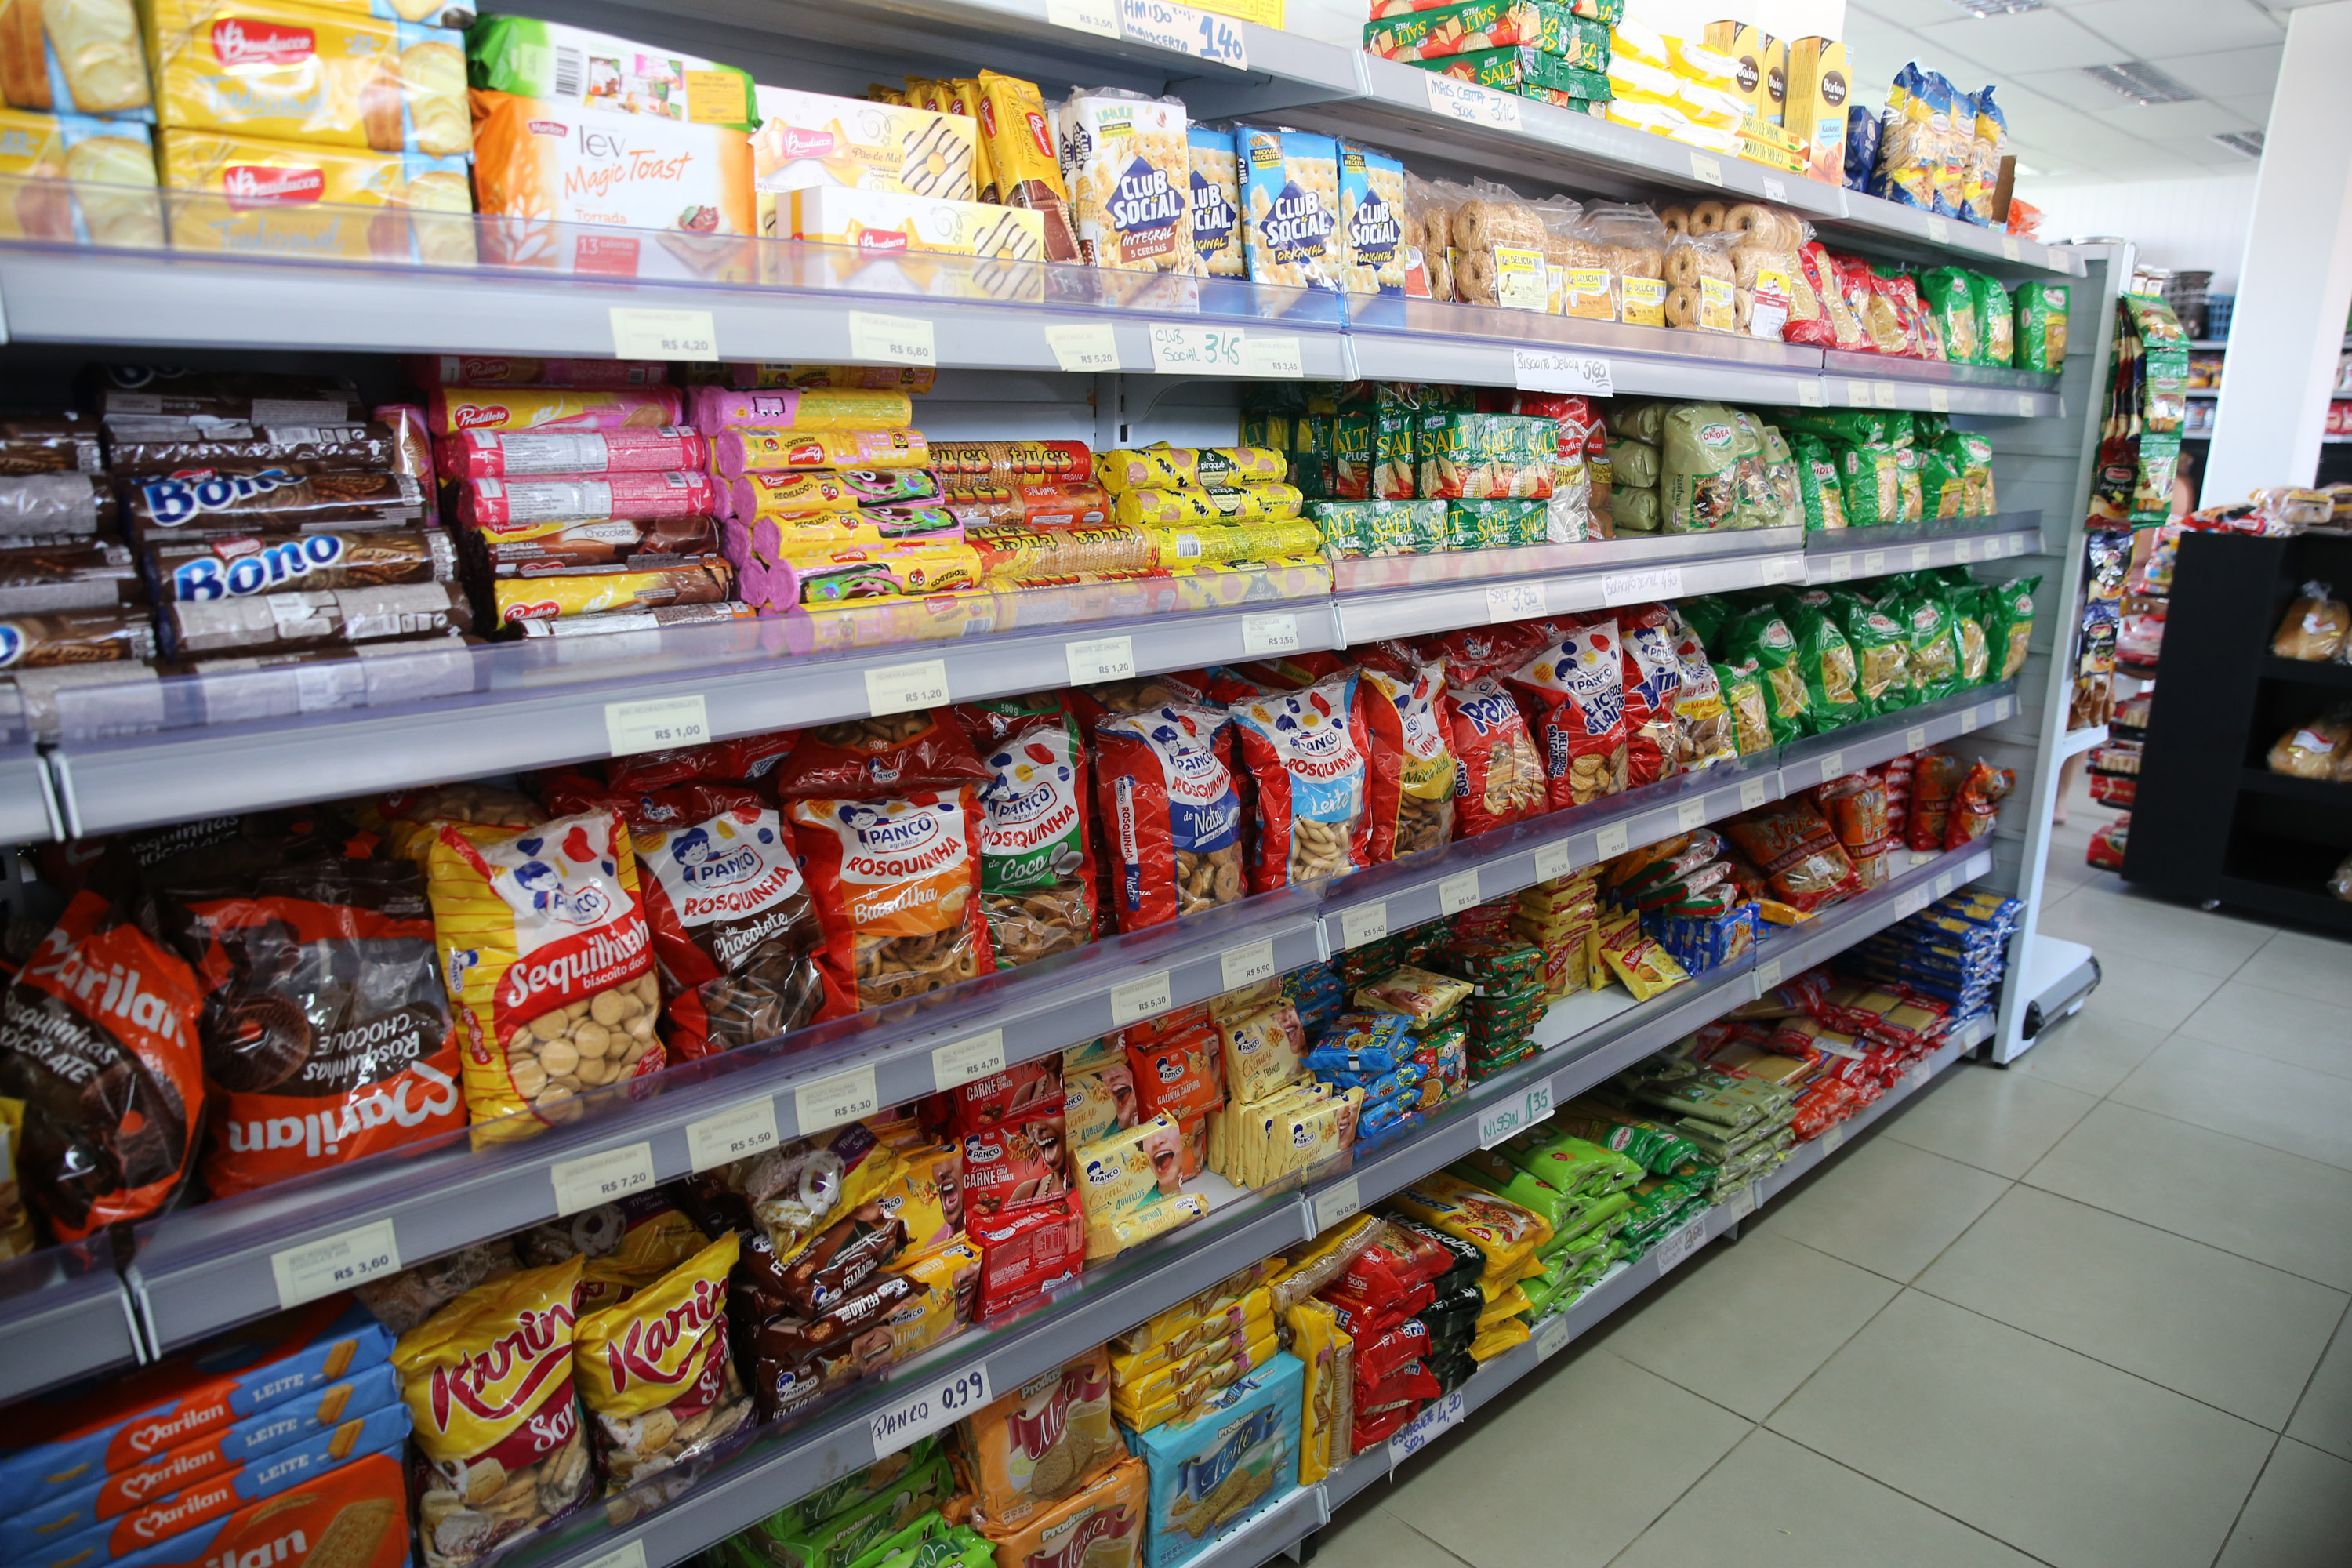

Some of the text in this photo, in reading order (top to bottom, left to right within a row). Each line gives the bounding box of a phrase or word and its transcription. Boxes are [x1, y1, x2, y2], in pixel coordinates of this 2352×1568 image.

[215, 19, 313, 59] Bauducco
[1823, 78, 1845, 96] Barion
[785, 132, 833, 158] Bauducco
[1028, 113, 1054, 158] Bauducco
[564, 149, 693, 199] Magic Toast
[1120, 170, 1168, 201] CLUB
[575, 209, 627, 225] Torrada
[1113, 191, 1180, 229] SOCIAL
[1275, 192, 1319, 221] CLUB
[1359, 201, 1390, 225] CLUB
[1122, 227, 1175, 247] INTEGRAL
[1131, 244, 1167, 259] 5 CEREAIS
[1277, 245, 1324, 261] ORIGINAL
[1359, 251, 1394, 263] ORIGINAL
[661, 339, 709, 352] R$ 4,20
[889, 343, 929, 358] R$ 6,80
[1080, 353, 1113, 365] R$ 5,20
[1272, 361, 1298, 372] R$ 3,45
[456, 406, 508, 426] Predilleto
[1421, 425, 1470, 457] SALT
[1481, 426, 1517, 459] SALT
[1009, 446, 1073, 474] tuc's
[1345, 451, 1370, 462] PLUS
[1448, 450, 1471, 461] PLUS
[773, 482, 815, 500] RECHEADOS
[1024, 485, 1058, 498] SALAME
[1675, 474, 1684, 506] Parafuso
[585, 527, 633, 539] Chocolate
[1372, 507, 1414, 543] SALT
[1338, 535, 1359, 548] PLUS
[1395, 533, 1416, 546] PLUS
[175, 533, 345, 602] Bono
[931, 568, 970, 588] RECHEADOS
[1269, 636, 1295, 647] R$ 3,55
[1098, 662, 1129, 674] R$ 1,20
[905, 688, 942, 704] R$ 1,20
[1000, 705, 1019, 716] 500g
[655, 724, 702, 739] R$ 1,00
[869, 740, 888, 752] 500g
[1177, 749, 1214, 771] PANCO
[1285, 746, 1358, 778] ROSQUINHA
[1171, 765, 1230, 800] ROSQUINHA
[998, 786, 1051, 818] PANCO
[1311, 789, 1350, 816] Leite
[870, 816, 932, 845] PANCO
[982, 803, 1076, 848] ROSQUINHA
[1183, 808, 1225, 833] de Nata
[889, 836, 920, 850] agradece
[699, 849, 757, 880] PANCO
[845, 835, 963, 877] ROSQUINHA
[1000, 855, 1048, 882] Coco
[683, 863, 795, 917] ROSQUINHA
[1126, 874, 1138, 904] Nata
[1459, 894, 1477, 906] R$ 5,40
[713, 911, 789, 964] Chocolate
[1374, 925, 1385, 935] 5,40
[582, 953, 648, 990] biscoito doce
[1247, 964, 1271, 978] R$ 5,90
[1139, 996, 1167, 1011] R$ 5,30
[967, 1057, 1000, 1075] R$ 4,70
[1242, 1048, 1274, 1076] Cremoso
[1263, 1062, 1281, 1077] FRANGO
[967, 1075, 1007, 1102] CARNE COM
[997, 1079, 1014, 1090] TOMATE
[1156, 1080, 1201, 1105] GALINHA CAIPIRA
[228, 1061, 459, 1158] Marilan
[835, 1099, 871, 1117] R$ 5,30
[731, 1131, 771, 1152] R$ 5,50
[602, 1172, 647, 1194] R$ 7,20
[963, 1167, 1008, 1189] CARNE COM
[996, 1173, 1015, 1183] TOMATE
[1094, 1167, 1120, 1183] PANCO
[1088, 1178, 1134, 1210] Cremoso
[1336, 1203, 1357, 1218] R$ 0,99
[1469, 1228, 1492, 1240] NISSIN
[334, 1255, 390, 1282] R$ 3,60
[1348, 1276, 1368, 1289] 500g
[1021, 1367, 1063, 1400] Prodasa
[129, 1372, 306, 1452] Marilan LEITE
[1217, 1411, 1254, 1440] Prodasa
[120, 1417, 298, 1499] Marilan LEITE
[1201, 1424, 1254, 1500] Leite
[132, 1452, 310, 1537] Marilan LEITE
[1040, 1503, 1095, 1542] Prodasa
